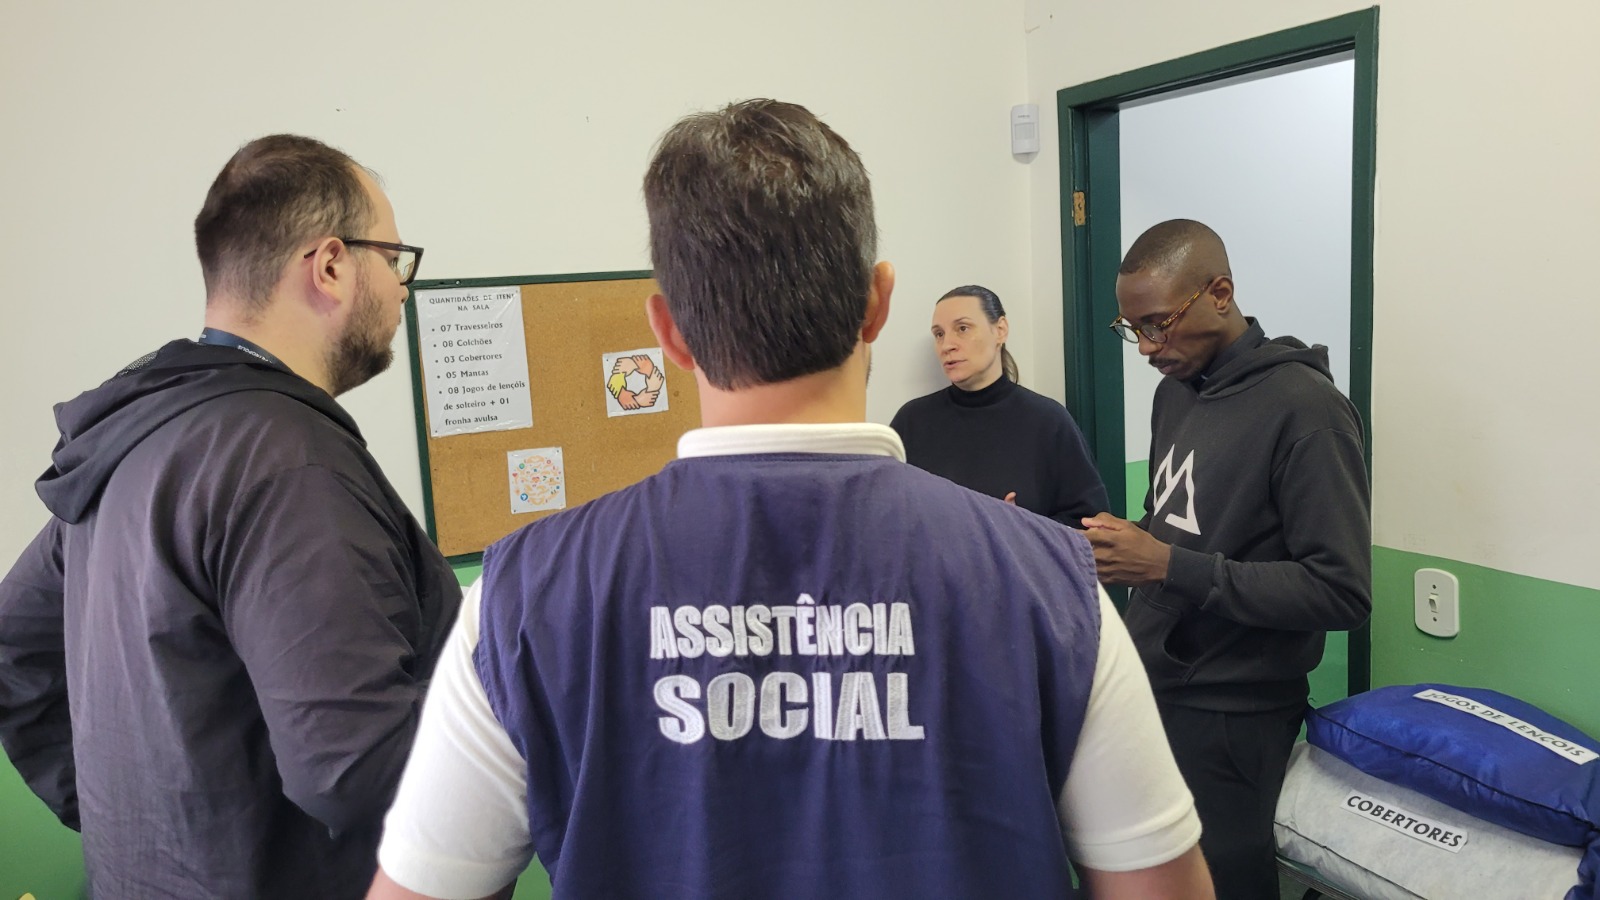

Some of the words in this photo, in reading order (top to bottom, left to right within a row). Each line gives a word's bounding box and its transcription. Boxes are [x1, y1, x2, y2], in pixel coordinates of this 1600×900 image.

[429, 295, 479, 304] QUANTIDADES
[440, 324, 451, 332] 07
[454, 321, 503, 331] Travesseiros
[442, 340, 453, 348] 08
[456, 338, 493, 347] Colchões
[444, 355, 455, 363] 03
[458, 353, 503, 362] Cobertores
[460, 370, 489, 378] Mantas
[448, 387, 459, 395] 08
[462, 386, 484, 395] Jogos
[499, 381, 525, 390] lençóis
[443, 403, 453, 411] de
[456, 400, 486, 409] solteiro
[445, 415, 472, 426] fronha
[474, 414, 498, 423] avulsa
[650, 593, 915, 659] ASSISTÊNCIA
[654, 672, 925, 744] SOCIAL
[1424, 692, 1480, 711] JOGOS
[1480, 709, 1504, 720] DE
[1346, 795, 1463, 848] COBERTORES
